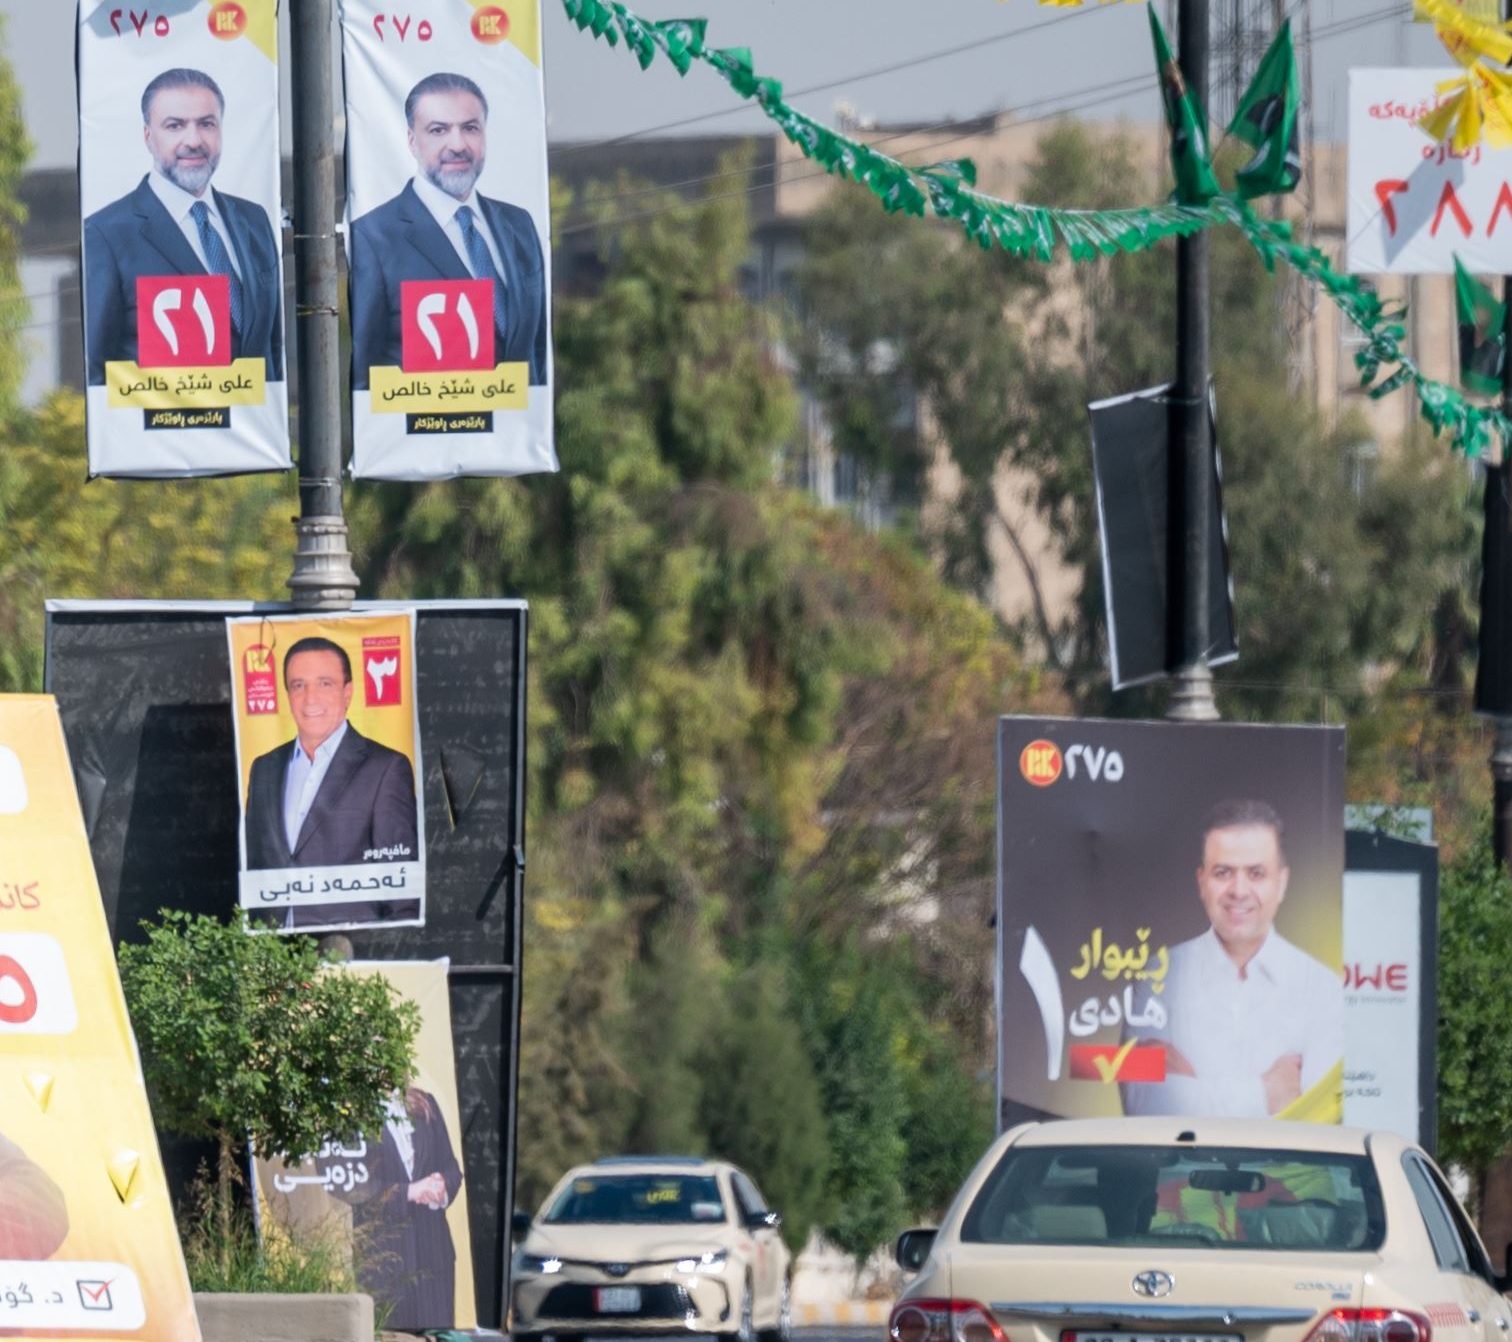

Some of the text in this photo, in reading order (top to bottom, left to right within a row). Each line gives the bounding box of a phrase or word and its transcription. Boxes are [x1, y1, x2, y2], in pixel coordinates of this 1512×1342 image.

[108, 9, 170, 39] ٢٧٥
[373, 13, 434, 44] ٢٧٥
[151, 286, 217, 357] ٢١
[416, 291, 480, 361] ٢١
[367, 656, 398, 701] ٣
[1062, 743, 1125, 782] ٢٧٥
[1019, 925, 1065, 1081] ١
[1069, 986, 1169, 1037] هادی
